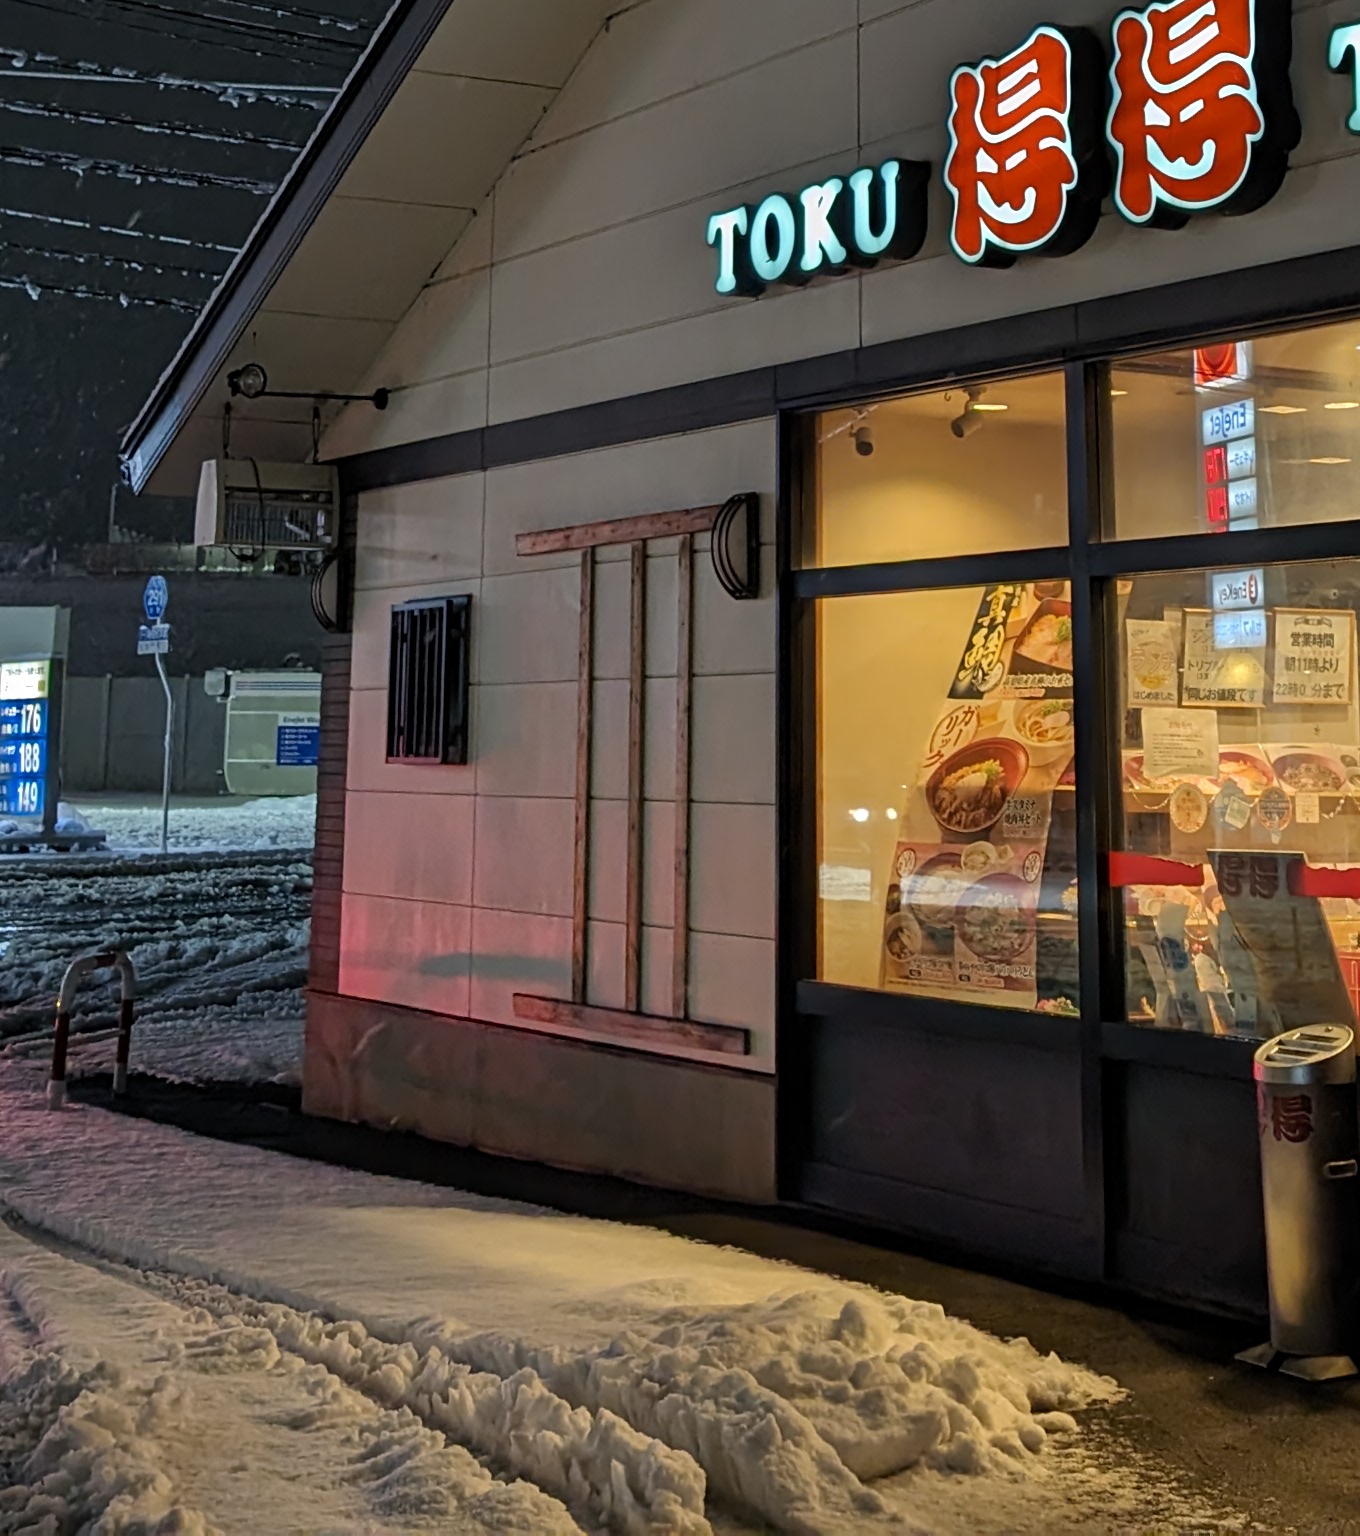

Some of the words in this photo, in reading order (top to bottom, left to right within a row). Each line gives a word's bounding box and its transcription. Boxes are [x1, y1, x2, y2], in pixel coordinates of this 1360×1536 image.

[707, 159, 901, 294] TOKU
[1290, 632, 1335, 648] 営業時間
[1284, 656, 1339, 674] 朝11時より
[1133, 690, 1175, 701] はじめました
[21, 704, 41, 735] 176
[19, 743, 40, 773] 188
[18, 782, 38, 812] 149
